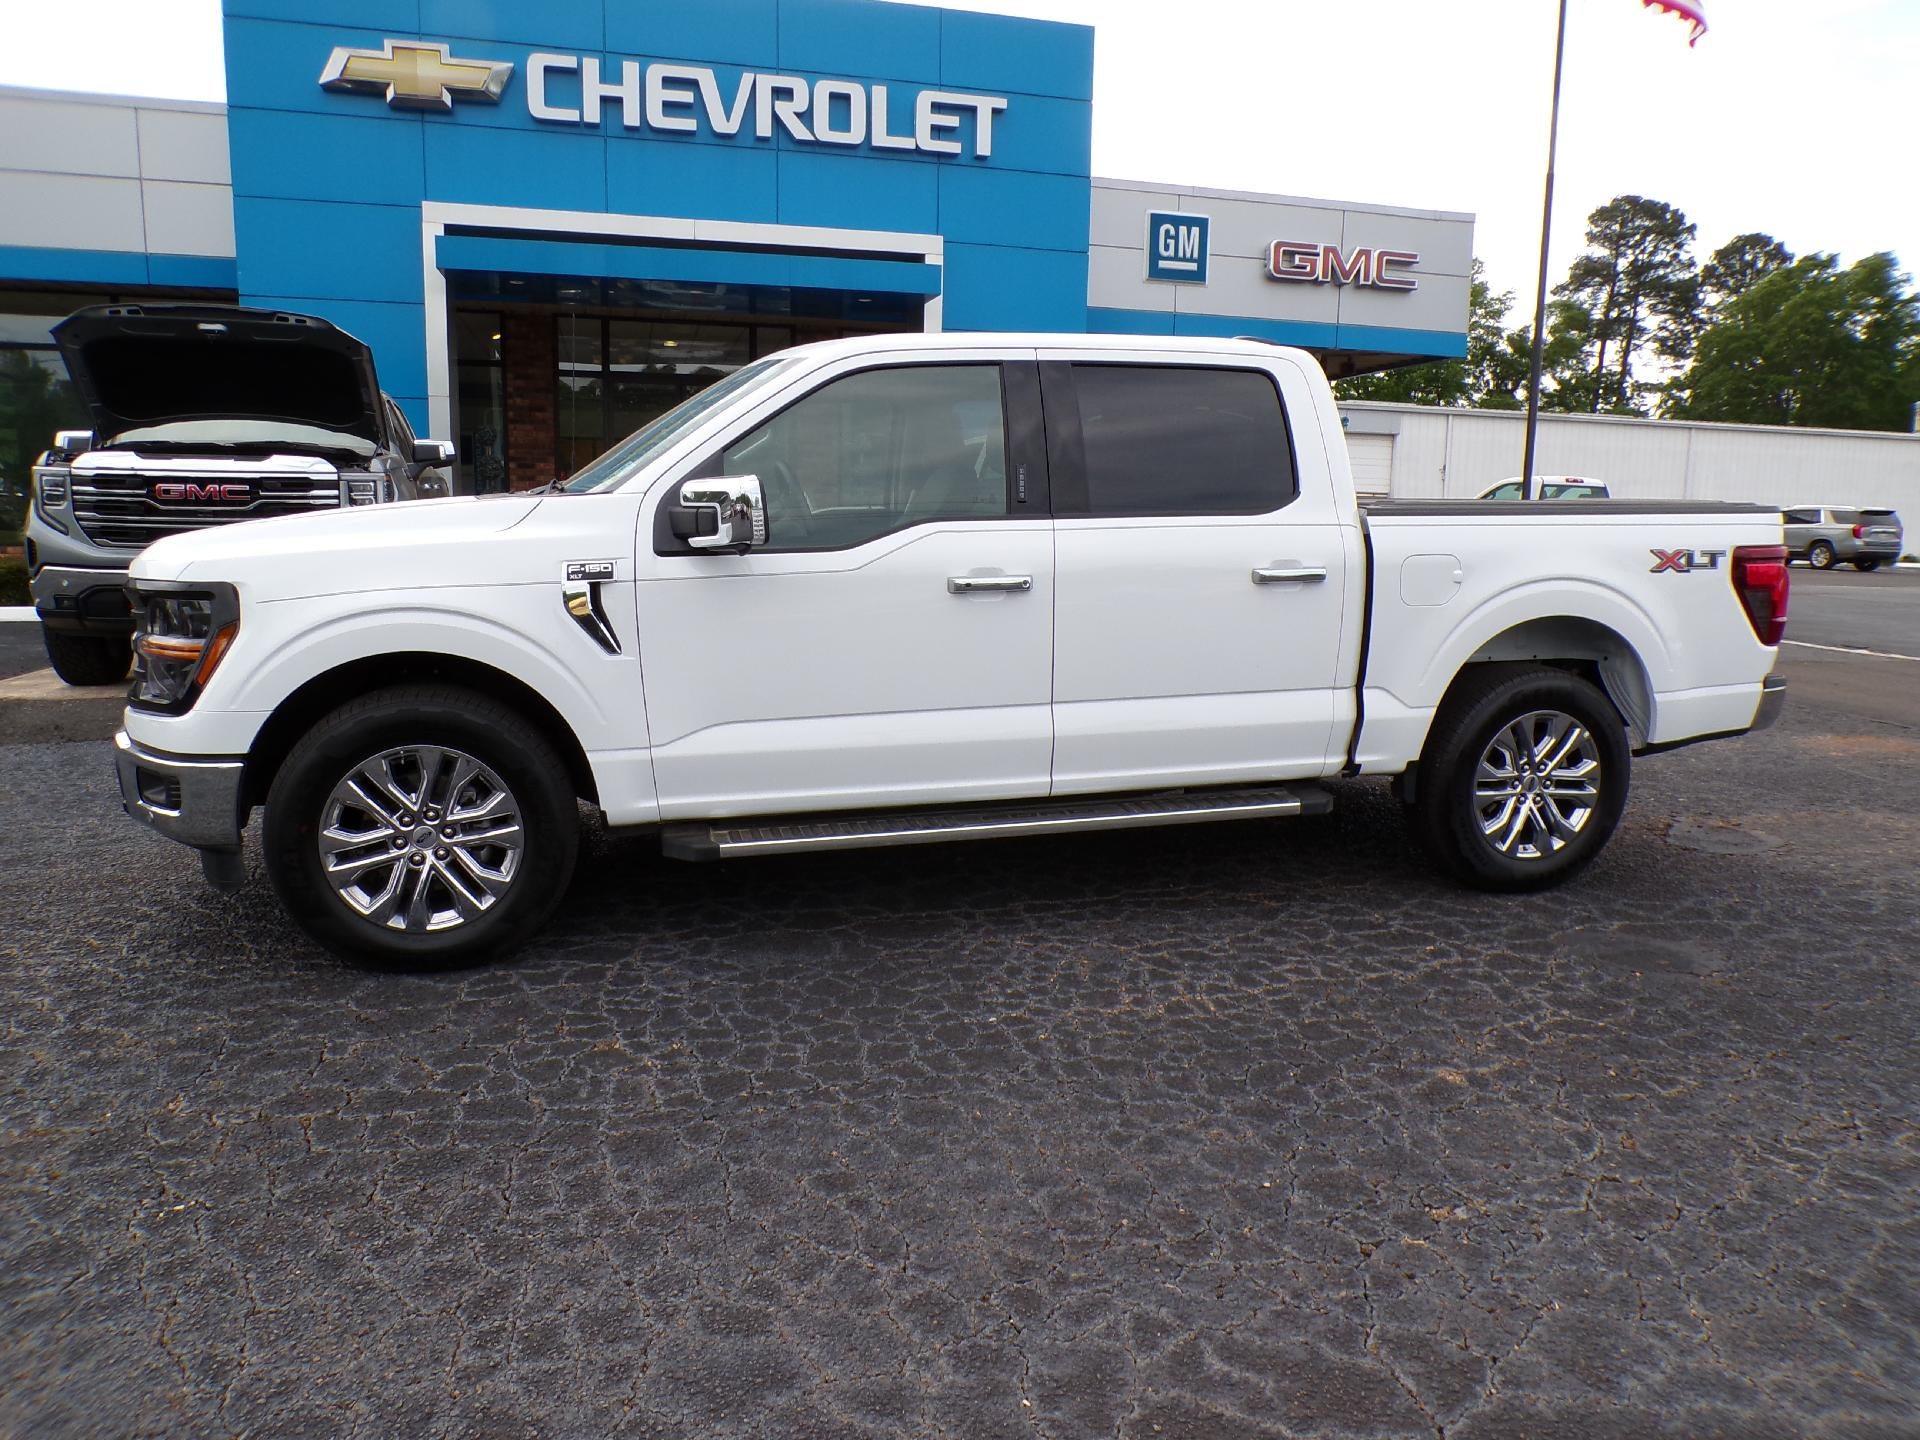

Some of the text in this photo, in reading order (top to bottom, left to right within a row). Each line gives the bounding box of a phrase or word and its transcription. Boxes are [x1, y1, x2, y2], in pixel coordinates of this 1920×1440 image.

[526, 53, 1008, 158] CHEVROLET
[1159, 223, 1199, 259] GM
[1269, 239, 1420, 289] GMC
[155, 483, 251, 501] GMC
[568, 563, 612, 573] F-150
[1650, 549, 1727, 573] XLT
